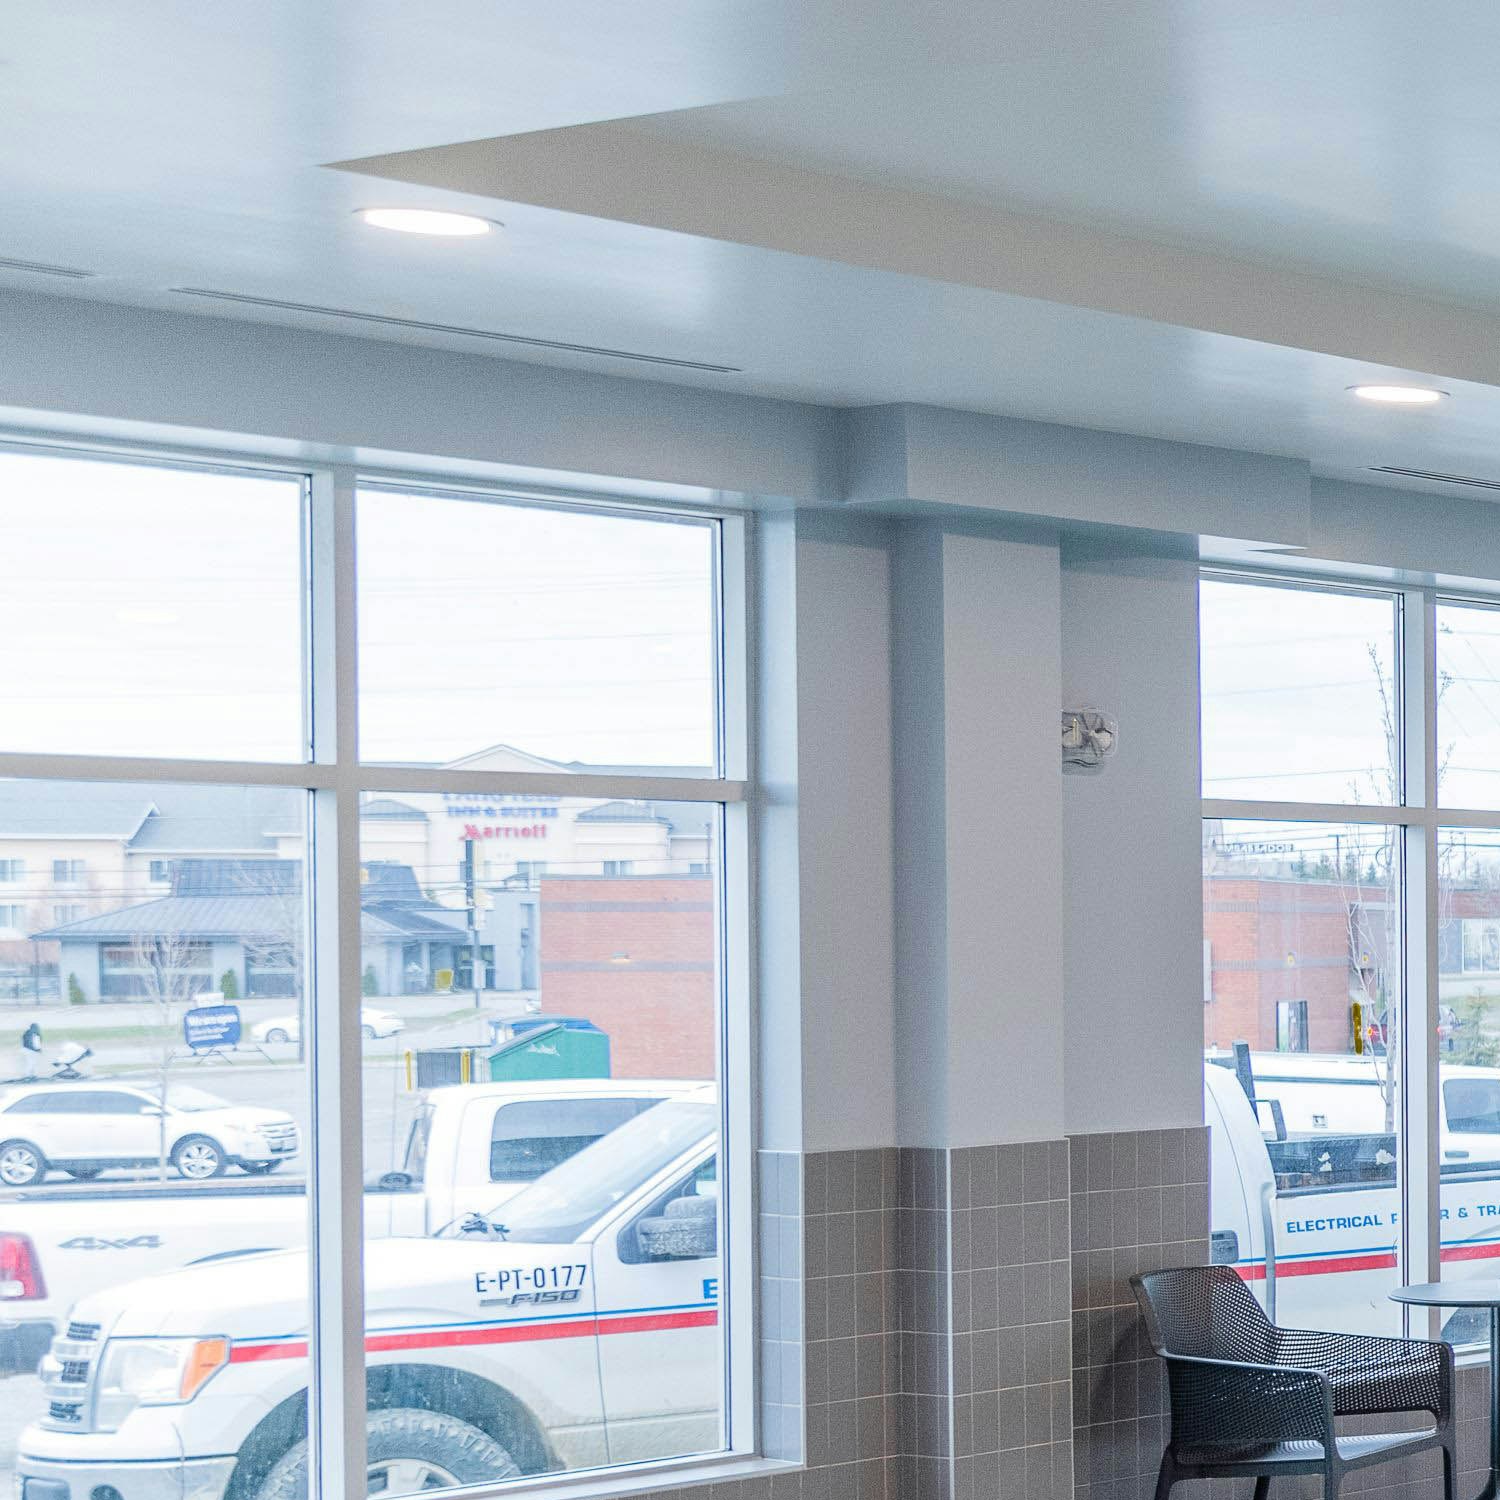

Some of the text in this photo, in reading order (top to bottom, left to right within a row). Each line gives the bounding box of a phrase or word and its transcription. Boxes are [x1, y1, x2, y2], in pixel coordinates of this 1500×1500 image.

[1286, 1215, 1383, 1234] ELECTRICAL
[1458, 1207, 1469, 1219] &
[475, 1264, 587, 1293] E-PT-0177
[510, 1289, 582, 1305] F-150
